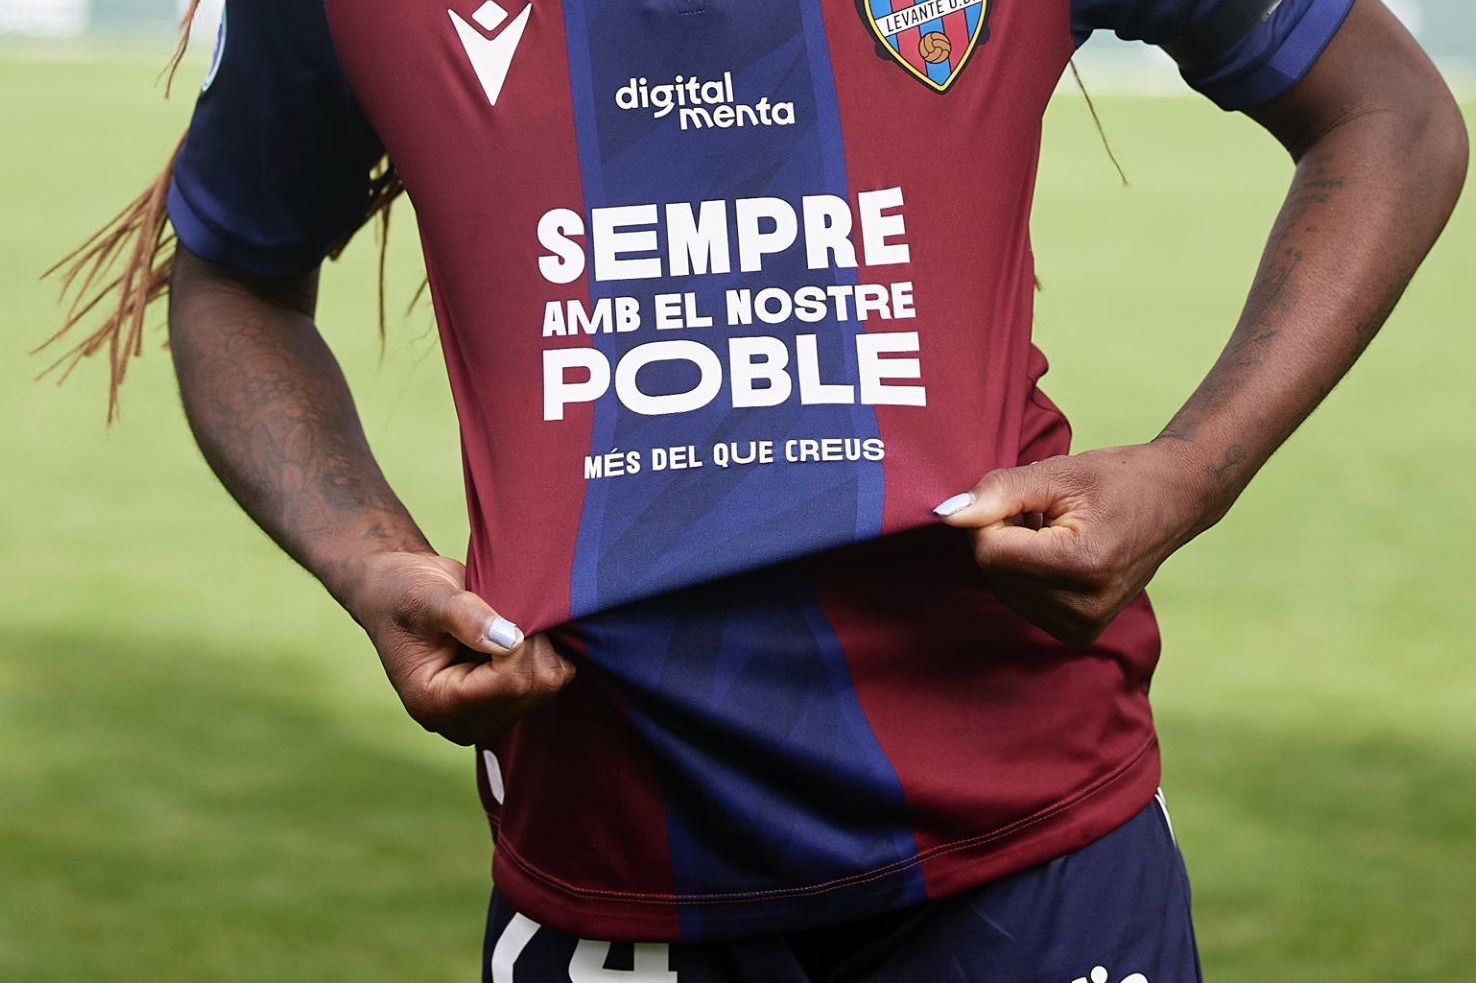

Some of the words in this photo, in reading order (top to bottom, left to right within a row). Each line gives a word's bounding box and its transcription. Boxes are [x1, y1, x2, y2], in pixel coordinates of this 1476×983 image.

[886, 0, 944, 33] LEVANTE
[615, 71, 734, 118] digital
[679, 96, 796, 131] menta
[536, 186, 911, 284] SEMPRE
[541, 296, 641, 337] AMB
[654, 291, 713, 331] EL
[725, 280, 916, 326] NOSTRE
[542, 331, 927, 421] POBLE
[583, 447, 641, 480] MÉS
[651, 444, 703, 472] DEL
[713, 440, 774, 468] QUE
[785, 437, 886, 464] CREUS
